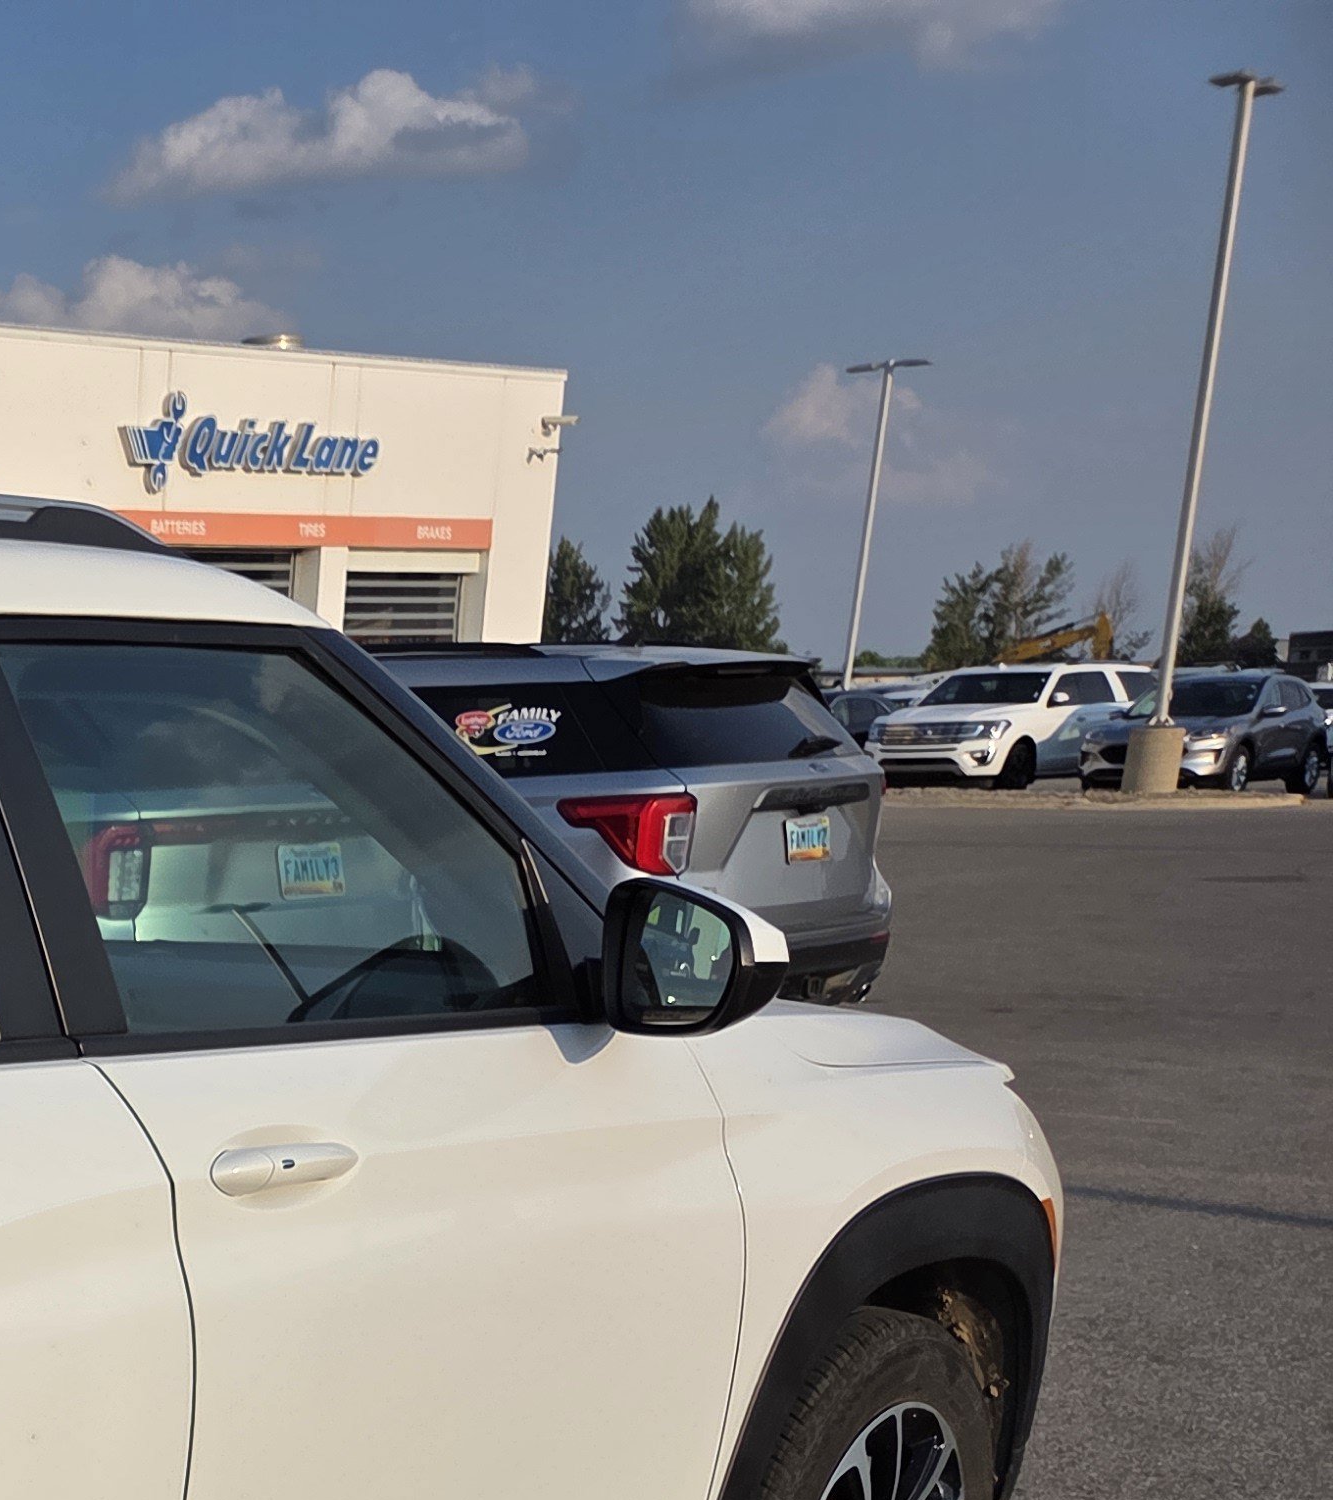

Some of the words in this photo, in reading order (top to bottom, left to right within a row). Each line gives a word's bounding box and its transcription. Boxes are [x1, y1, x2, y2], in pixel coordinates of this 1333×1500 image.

[149, 518, 207, 537] BATTERIES
[298, 521, 327, 538] TIRES
[416, 524, 453, 541] BRAKES
[496, 706, 562, 725] FAMILY
